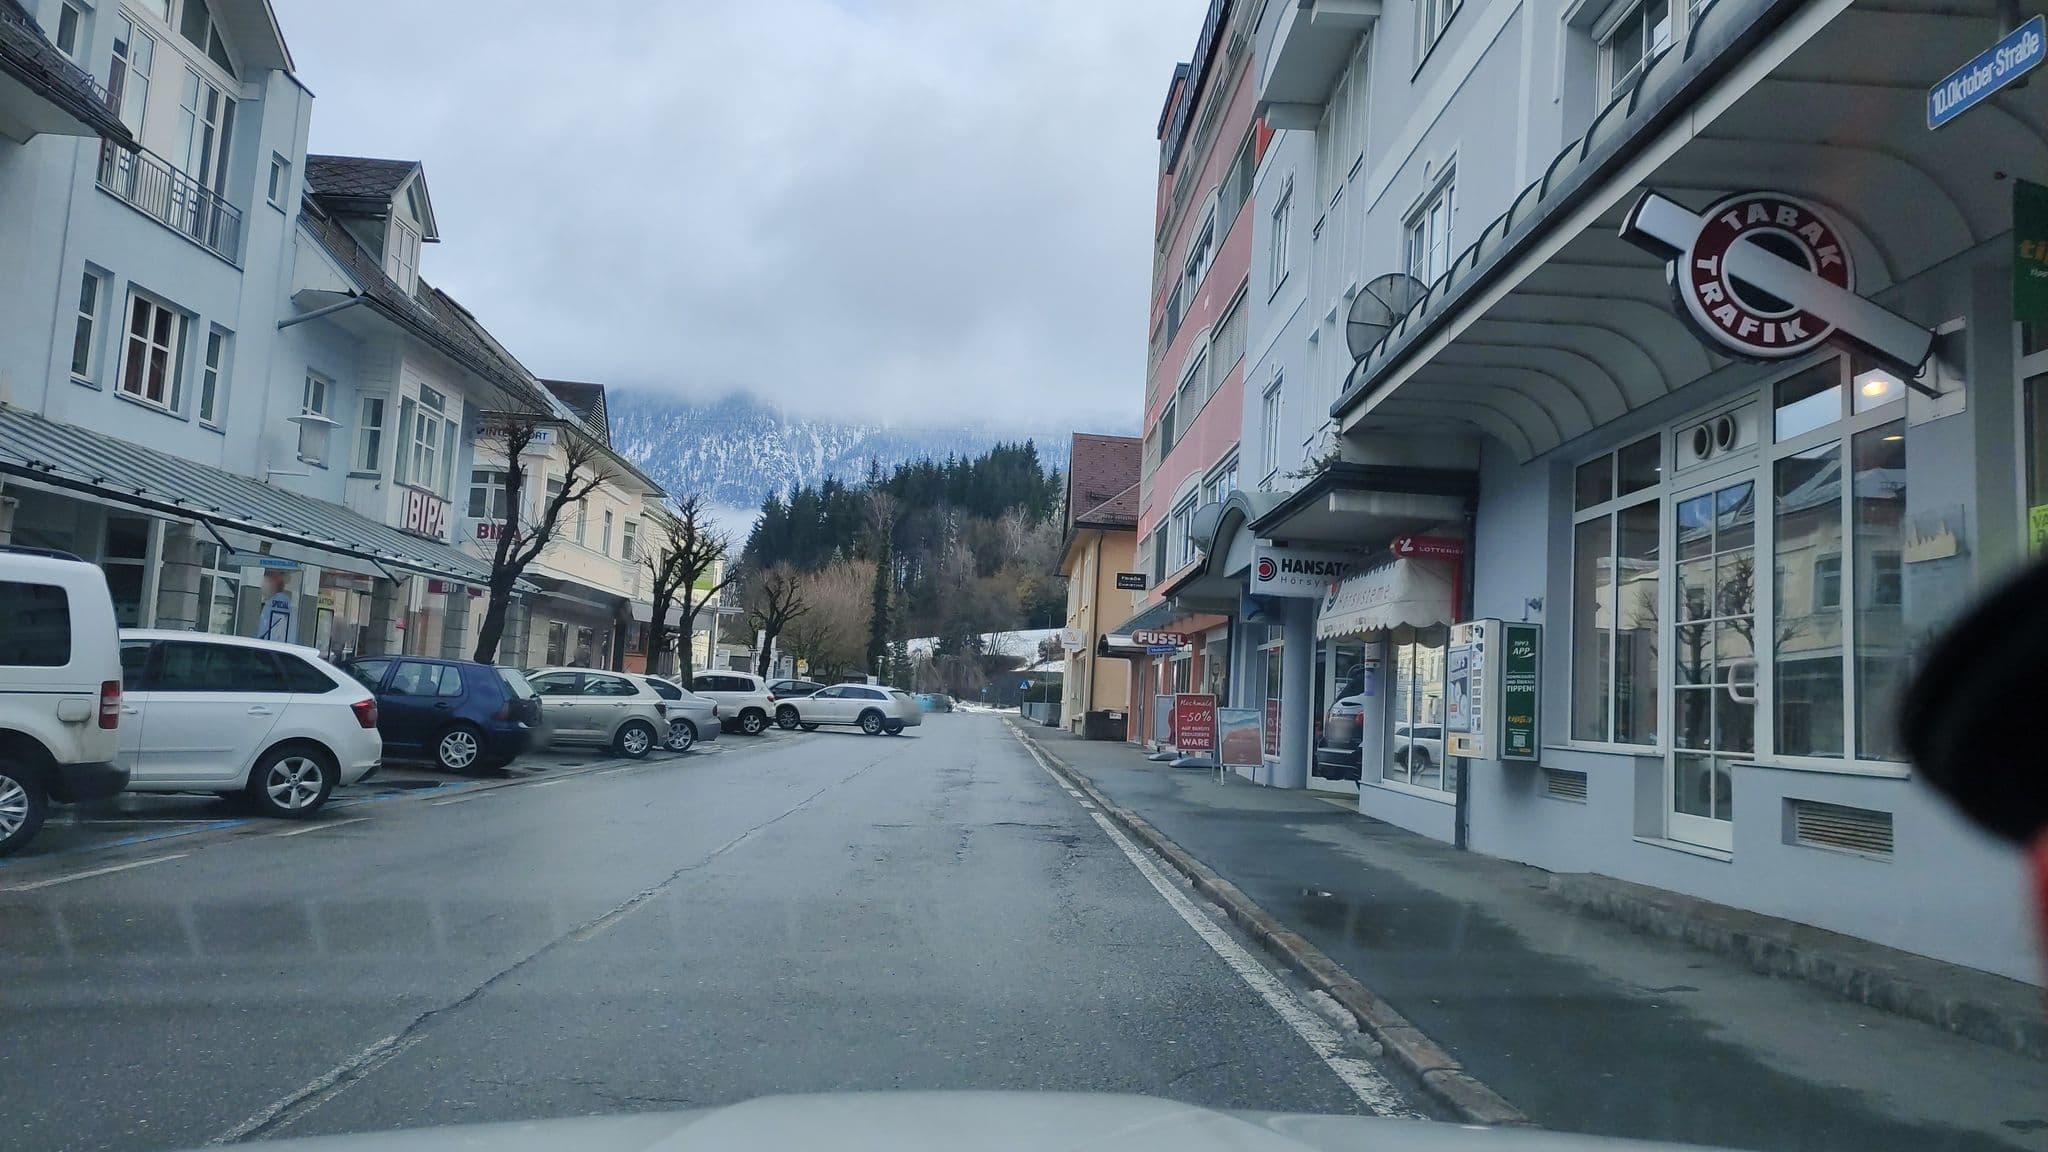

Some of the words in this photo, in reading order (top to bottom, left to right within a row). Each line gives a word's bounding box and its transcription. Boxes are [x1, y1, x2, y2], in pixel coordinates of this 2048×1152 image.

[1720, 202, 1842, 269] TABAK
[1696, 254, 1810, 344] TRAFIK
[407, 490, 446, 539] BIPA
[1137, 631, 1185, 646] FUSSL
[1511, 647, 1531, 655] APP
[1506, 685, 1535, 693] TIPPEN!
[1180, 710, 1212, 722] -50%
[1181, 738, 1210, 747] WARE
